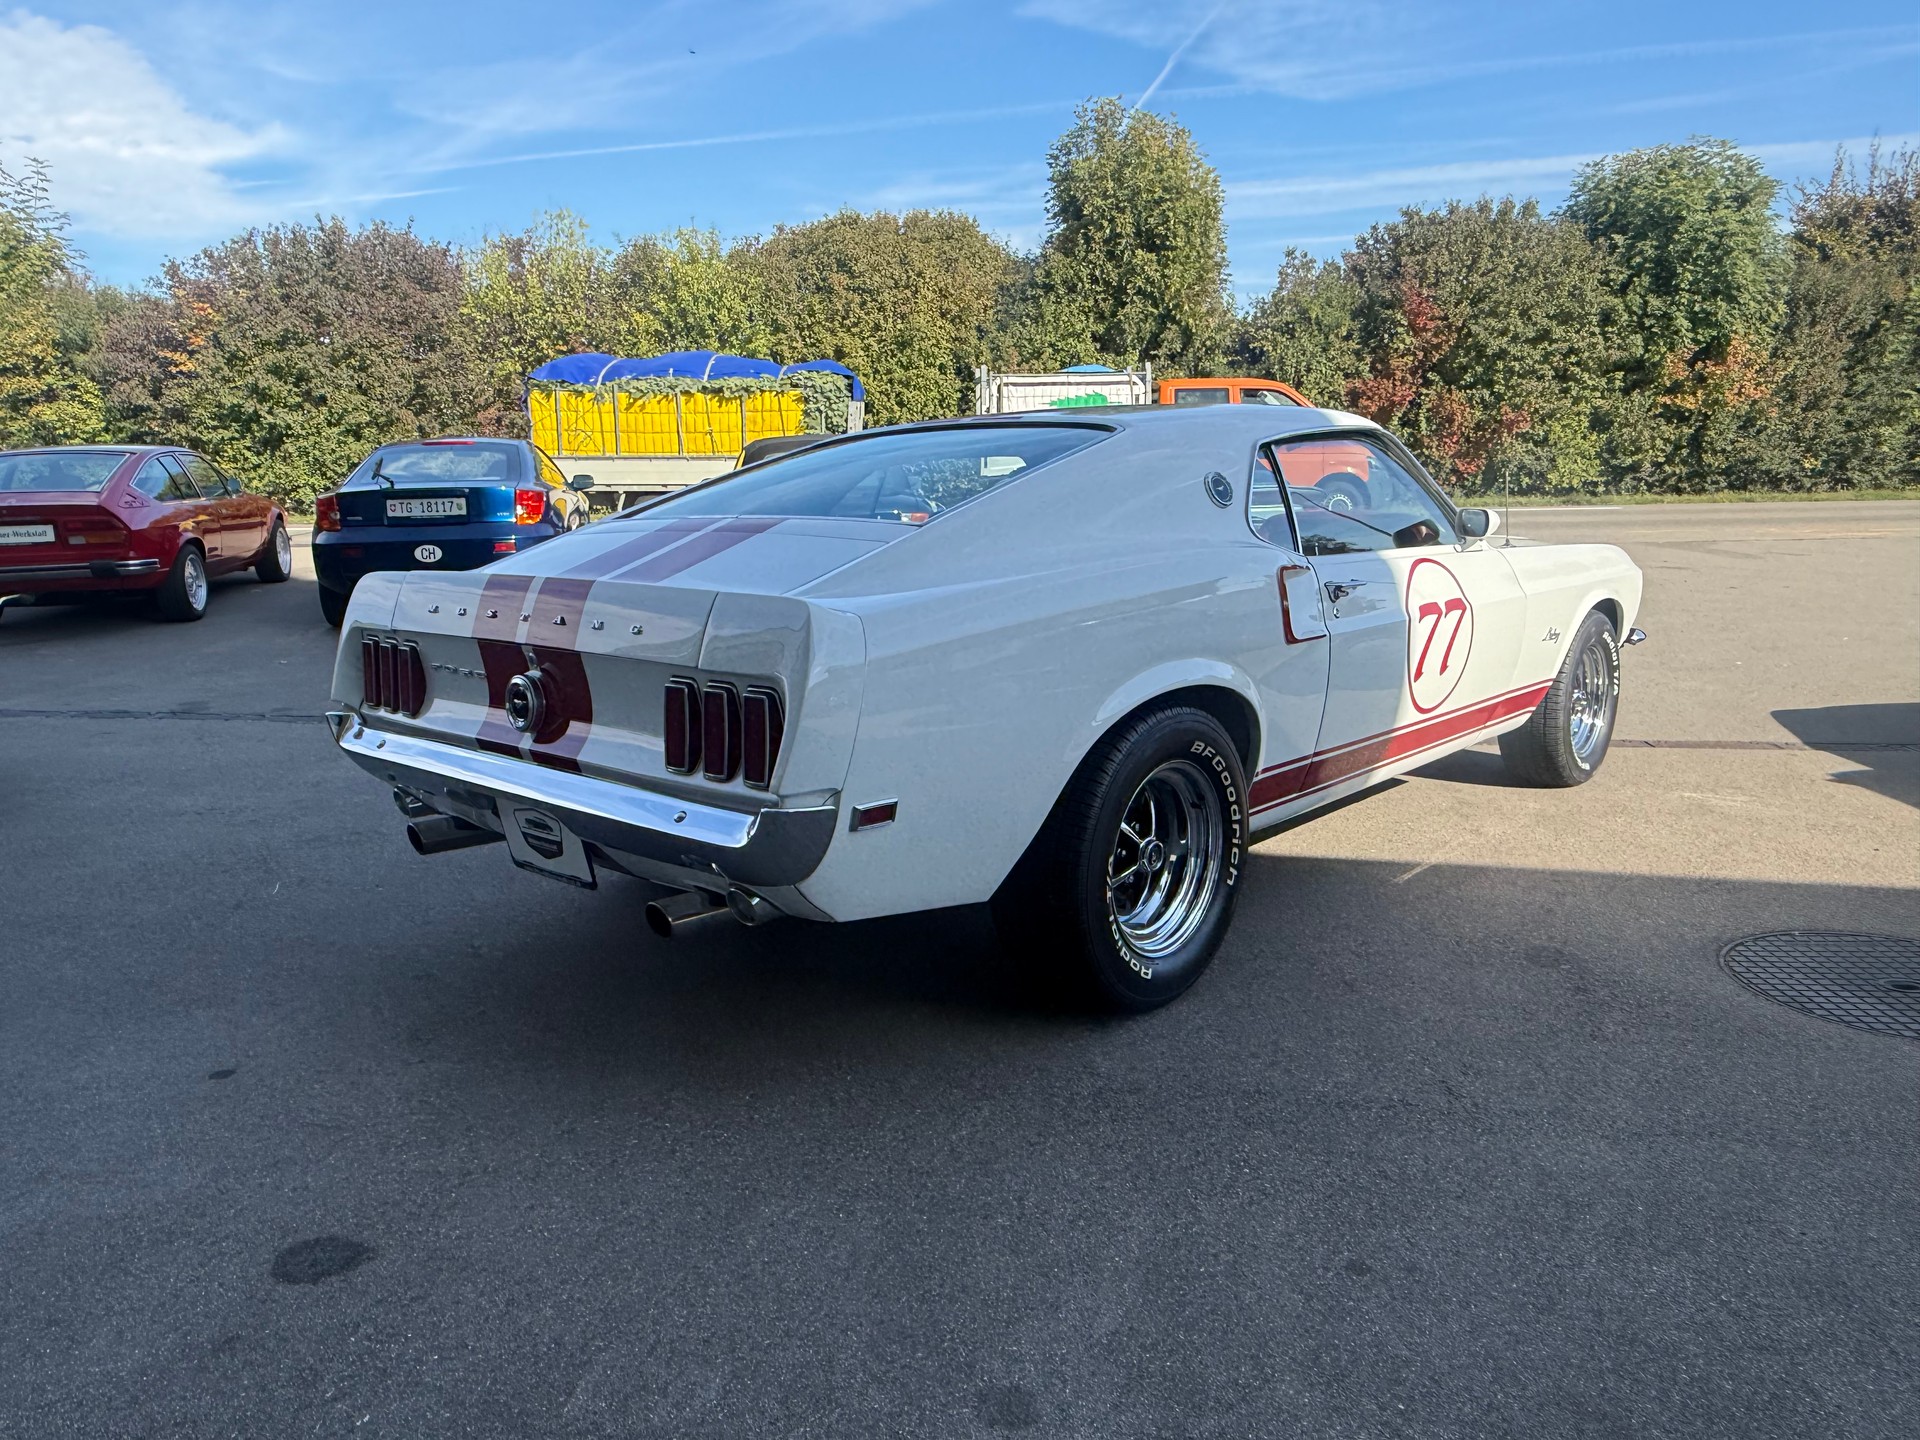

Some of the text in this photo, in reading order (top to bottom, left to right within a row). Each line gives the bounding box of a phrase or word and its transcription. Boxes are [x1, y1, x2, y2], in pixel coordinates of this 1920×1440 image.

[398, 500, 454, 514] TG 18117
[420, 547, 436, 560] CH
[427, 604, 645, 636] MUSTANG
[1413, 597, 1467, 683] 77
[1190, 740, 1242, 886] BFGoodrich
